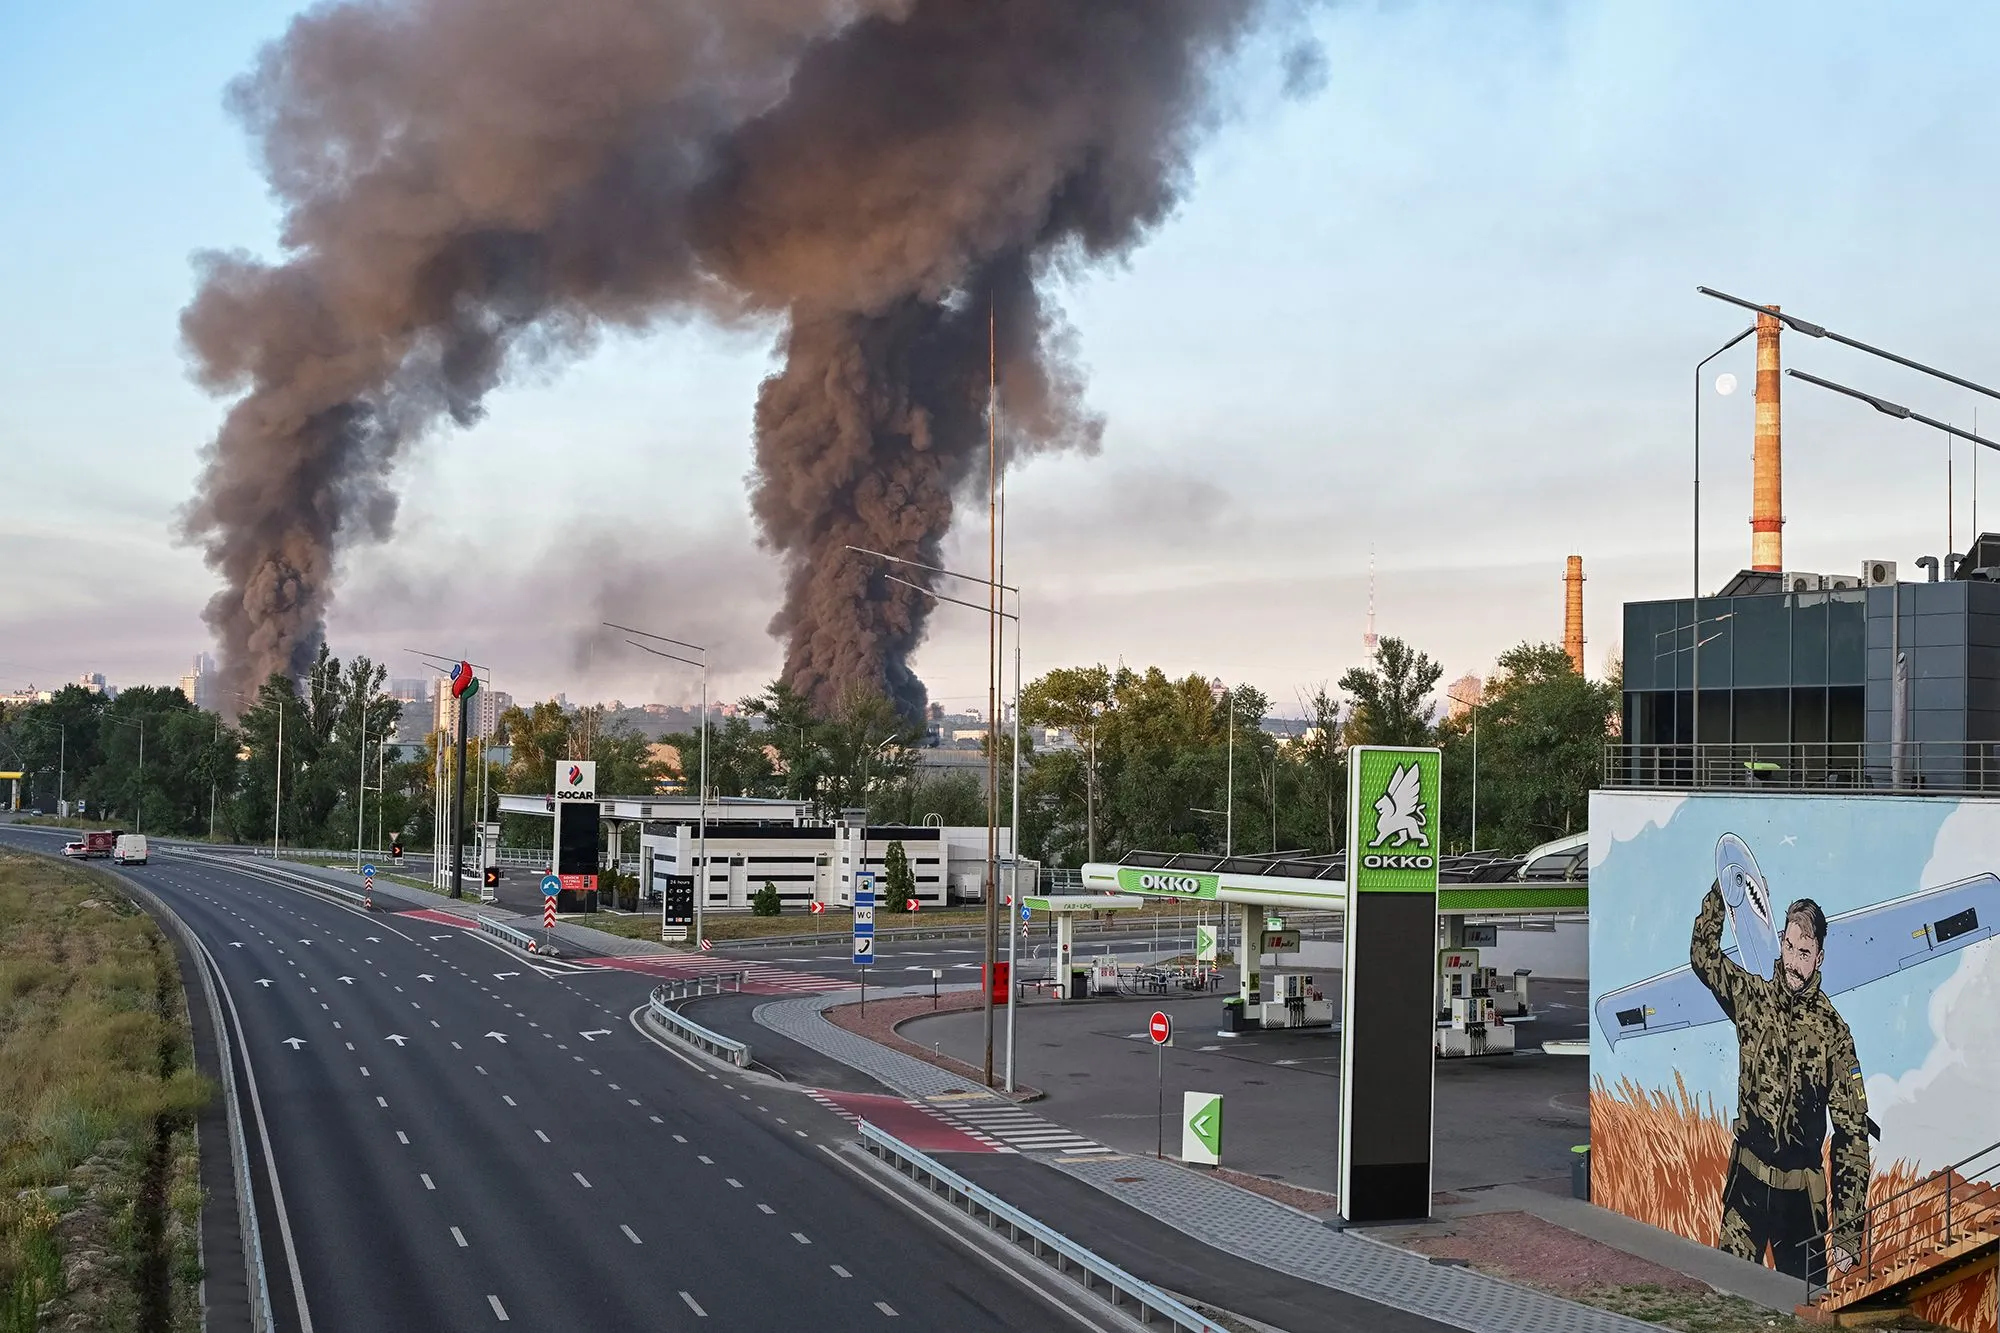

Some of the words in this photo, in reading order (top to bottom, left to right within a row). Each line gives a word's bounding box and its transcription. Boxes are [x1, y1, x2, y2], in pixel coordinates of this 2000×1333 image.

[557, 791, 593, 800] SOCAR
[1364, 855, 1433, 868] OKKO
[1140, 874, 1199, 893] OKKO
